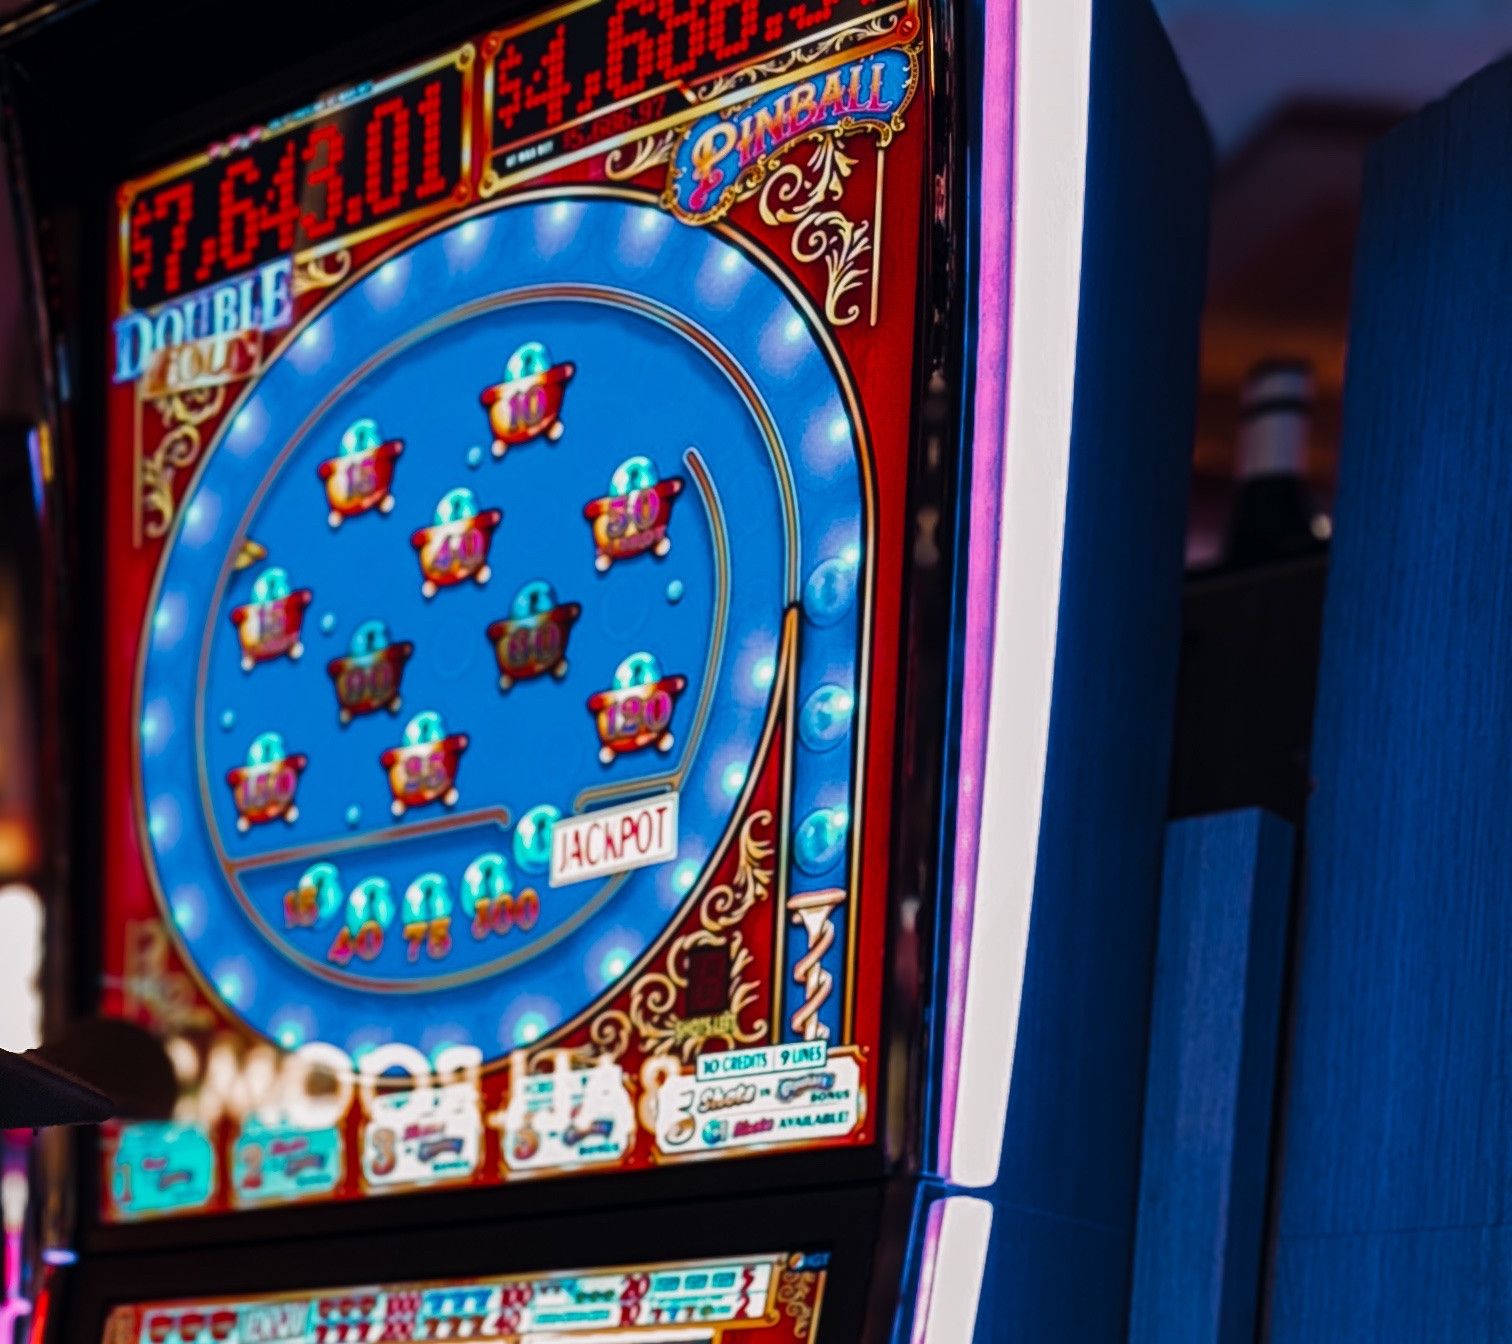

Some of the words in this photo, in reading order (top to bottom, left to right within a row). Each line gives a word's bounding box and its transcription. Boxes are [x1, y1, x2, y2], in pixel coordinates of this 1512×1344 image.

[131, 81, 446, 292] $7,643.01
[690, 60, 893, 210] PINBALL
[112, 257, 293, 385] DOUBLE
[558, 806, 669, 873] JACKPOT
